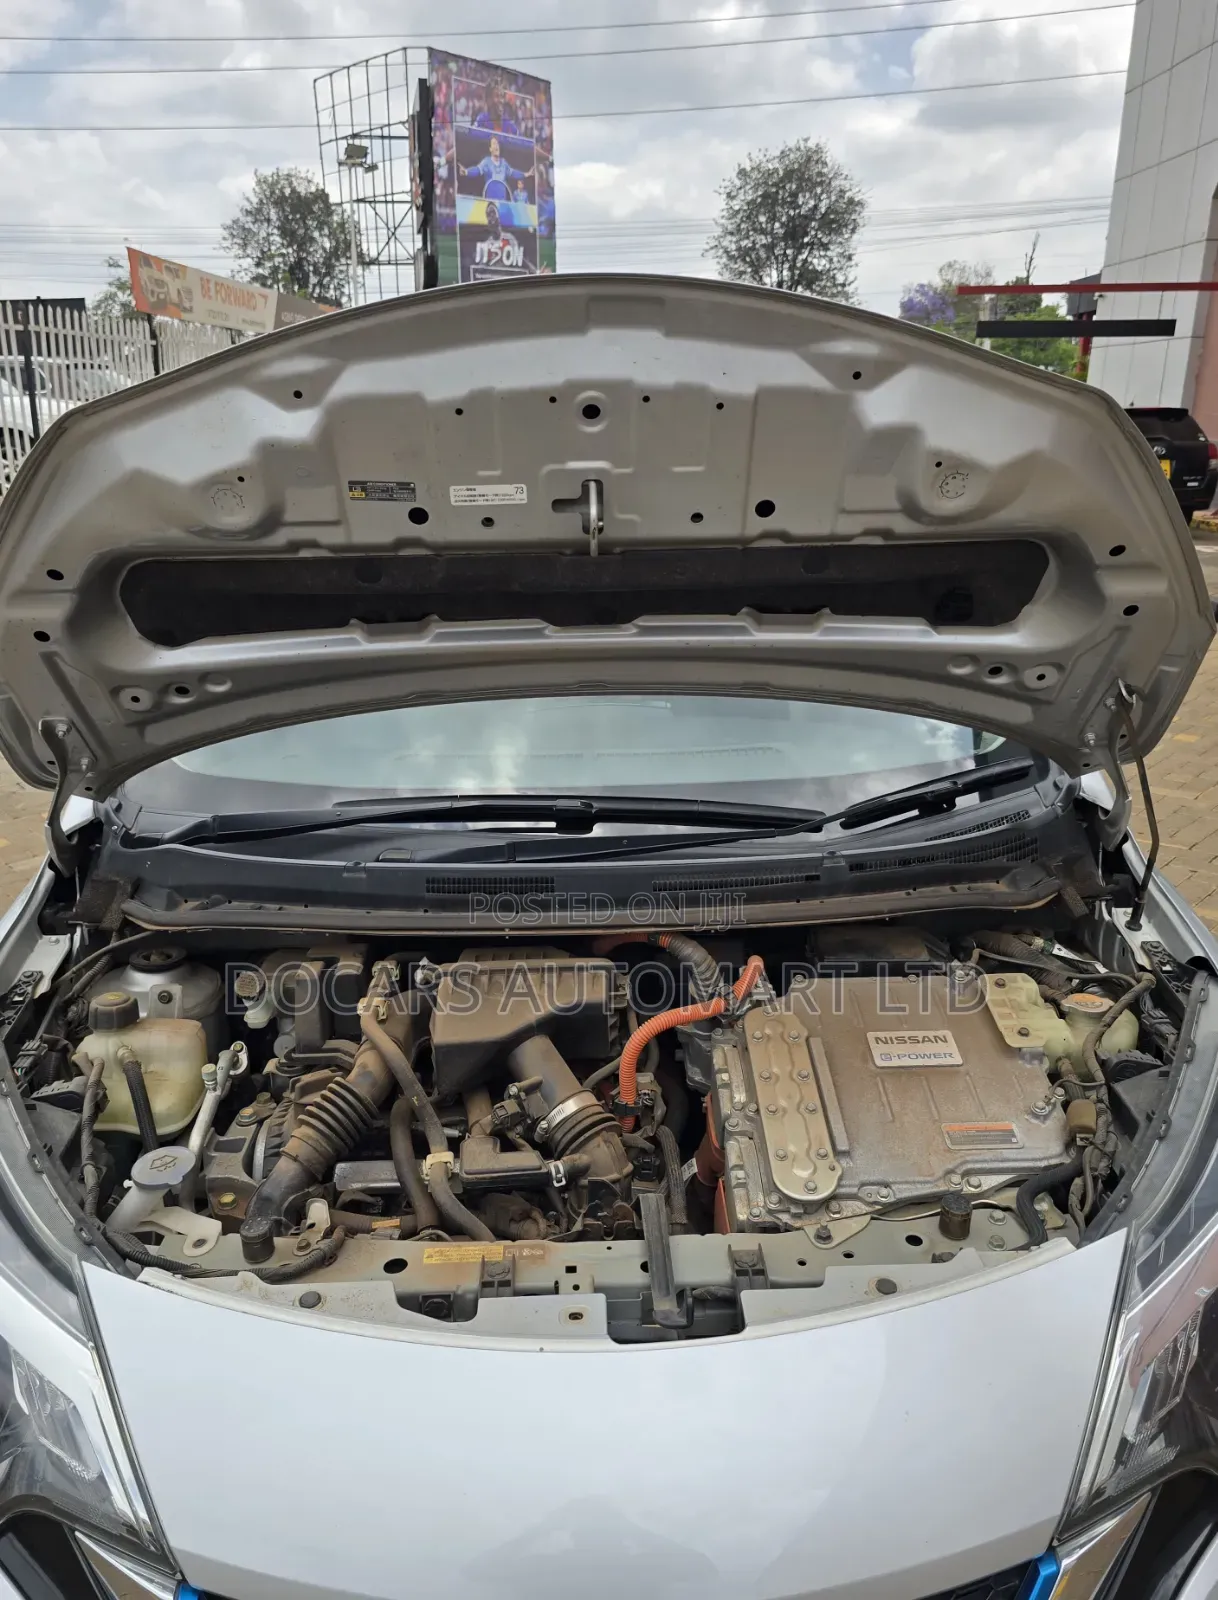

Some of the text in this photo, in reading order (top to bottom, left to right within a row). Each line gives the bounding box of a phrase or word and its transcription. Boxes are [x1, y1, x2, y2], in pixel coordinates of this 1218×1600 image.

[200, 276, 258, 312] BE FORWARD
[513, 486, 525, 495] 73
[874, 1035, 948, 1045] NISSAN
